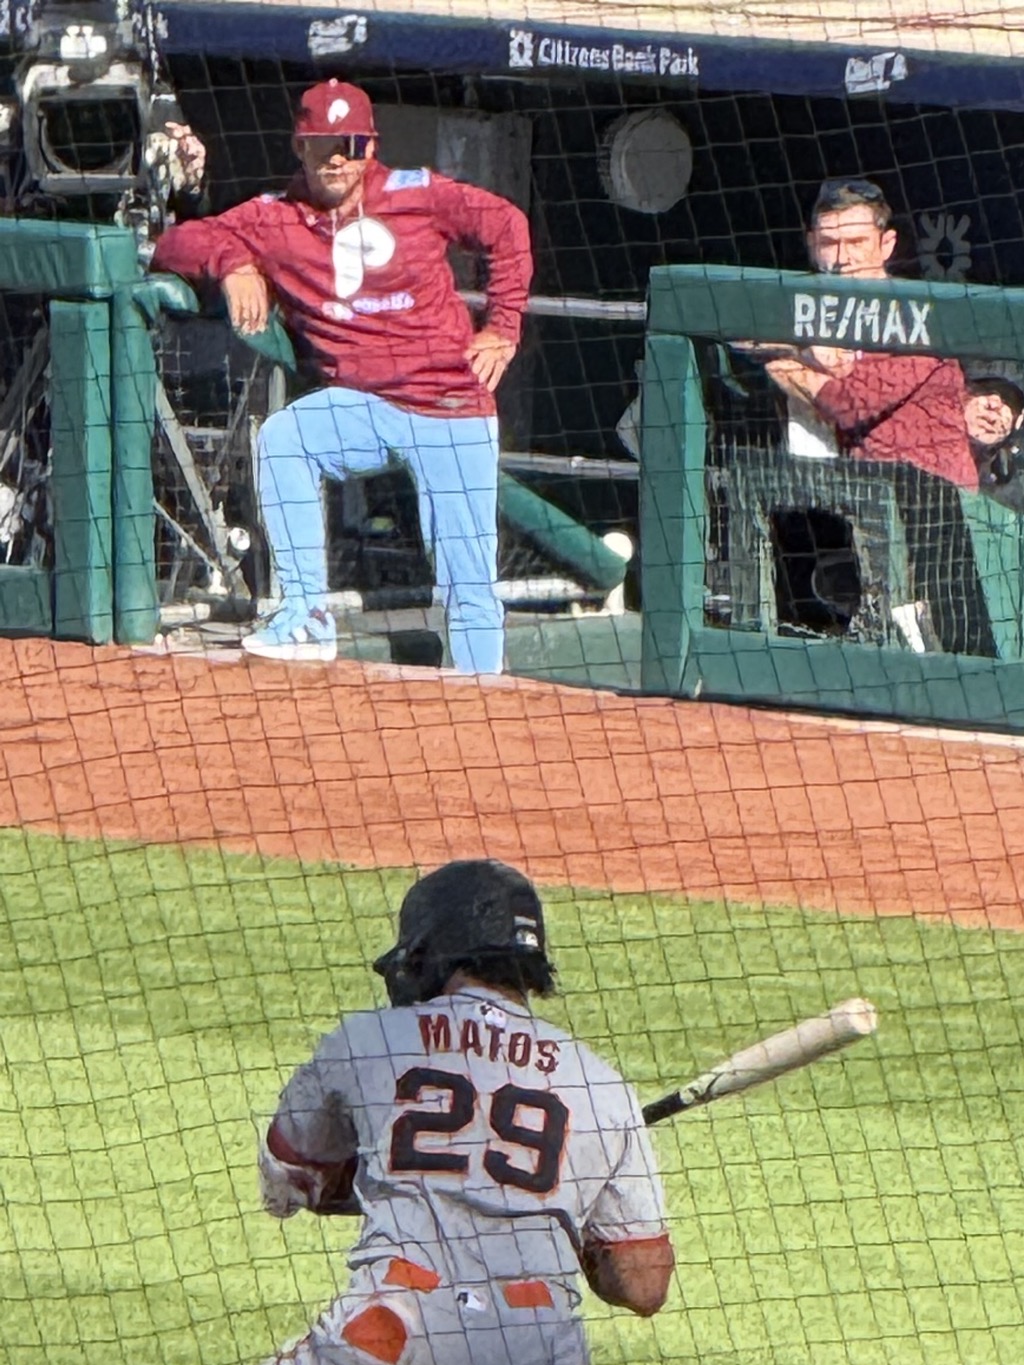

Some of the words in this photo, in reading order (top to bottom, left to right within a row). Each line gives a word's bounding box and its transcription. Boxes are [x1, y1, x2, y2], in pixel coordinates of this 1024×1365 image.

[612, 43, 657, 74] Bank
[659, 46, 699, 76] Park
[793, 292, 931, 346] RE/MAX
[417, 1013, 561, 1075] MATOS
[389, 1066, 570, 1197] 29
